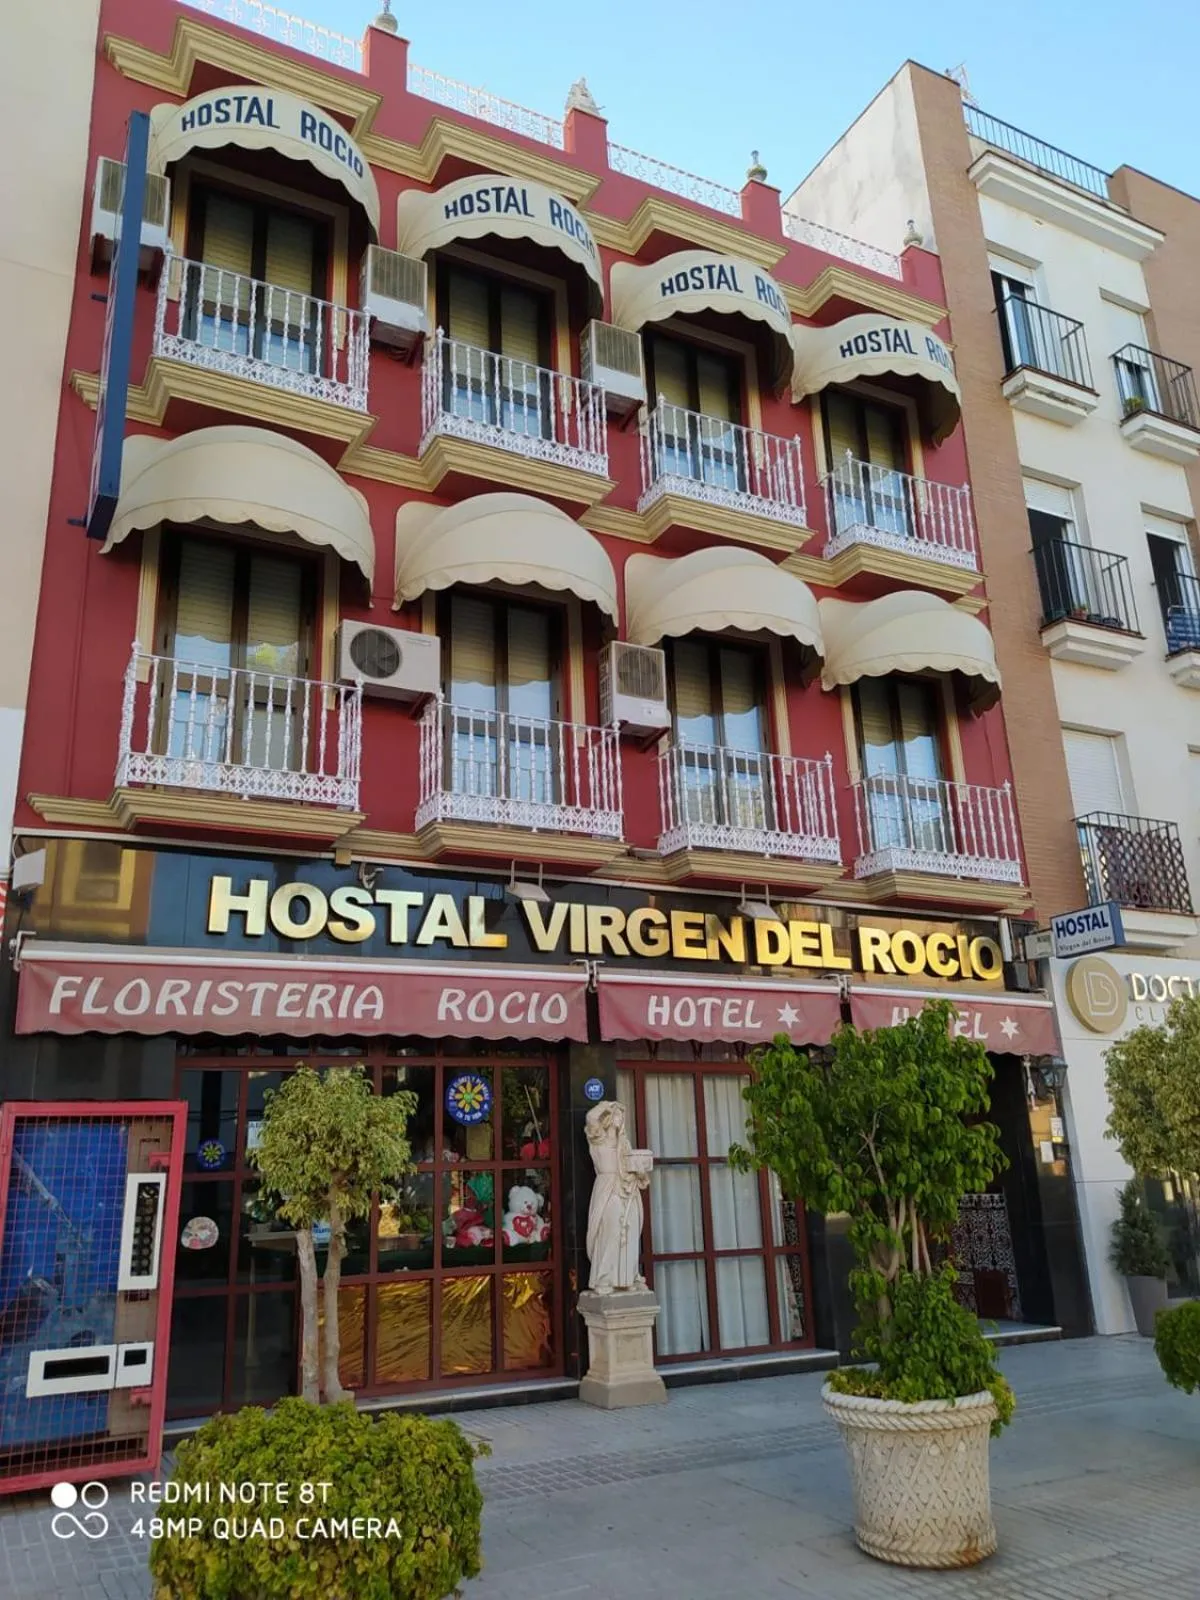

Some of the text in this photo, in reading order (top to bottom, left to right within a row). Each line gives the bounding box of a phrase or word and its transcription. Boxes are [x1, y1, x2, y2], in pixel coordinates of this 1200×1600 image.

[181, 95, 364, 179] HOSTAL ROCIO
[444, 186, 535, 219] HOSTAL
[660, 263, 744, 297] HOSTAL
[839, 327, 919, 358] HOSTAL
[207, 875, 1003, 981] HOSTAL VIRGEN DEL ROCIO
[1055, 910, 1110, 939] HOSTAL
[48, 975, 569, 1025] FLORISTERIA ROCIO
[647, 993, 764, 1029] HOTEL
[891, 1006, 989, 1040] HEL
